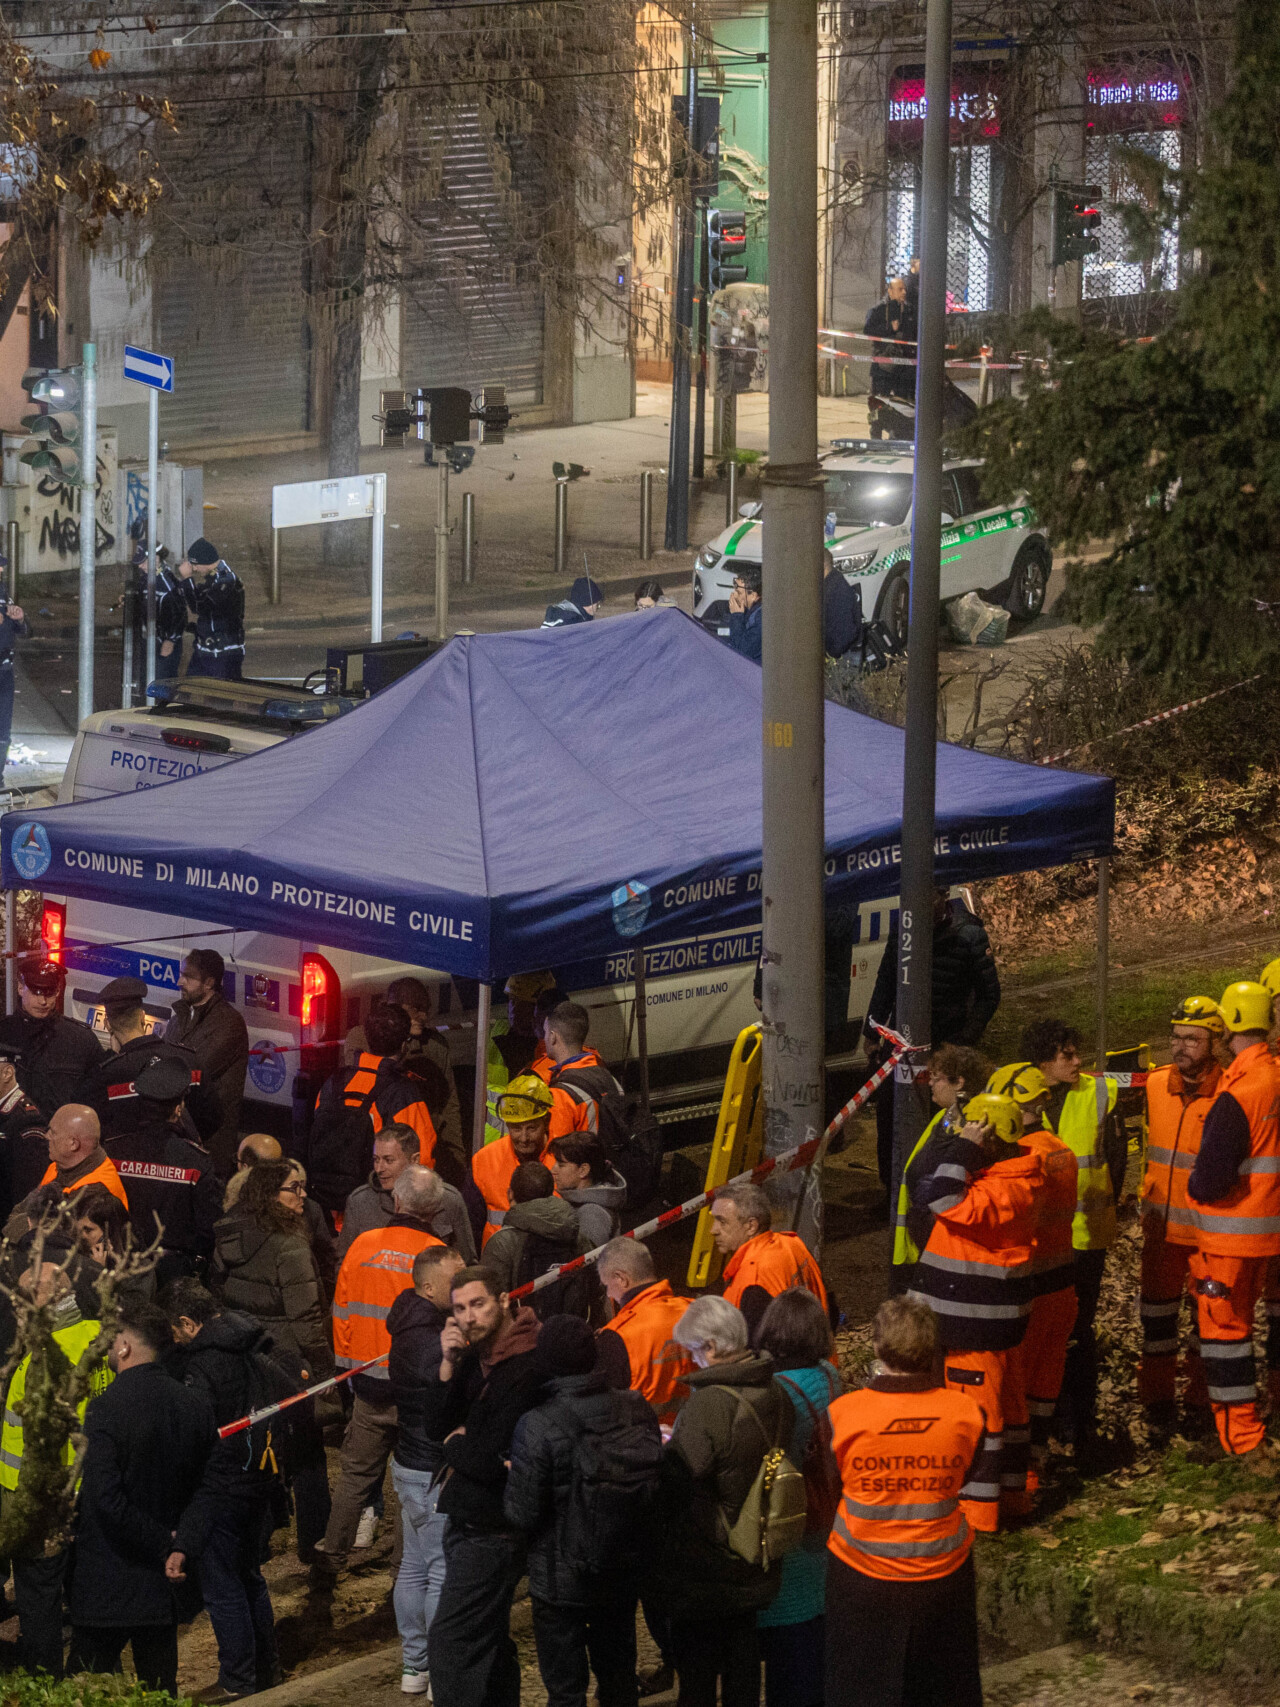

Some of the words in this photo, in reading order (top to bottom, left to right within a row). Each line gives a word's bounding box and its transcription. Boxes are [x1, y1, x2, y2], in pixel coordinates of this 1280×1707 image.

[1149, 81, 1179, 101] vista
[981, 517, 1008, 534] Locale
[663, 872, 737, 909] COMUNE
[959, 825, 1010, 851] CIVILE
[64, 848, 144, 878] COMUNE
[156, 862, 174, 882] DI
[185, 866, 260, 896] MILANO
[270, 881, 396, 925] PROTEZIONE
[409, 910, 474, 942] CIVILE
[605, 942, 708, 982] PROTEZIONE
[713, 935, 761, 962] CIVILE
[139, 958, 176, 983] PCA
[647, 992, 683, 1007] COMUNE
[685, 990, 694, 999] DI
[695, 982, 728, 998] MILANO
[121, 1161, 186, 1180] CARABINIERI
[852, 1454, 964, 1471] CONTROLLO
[862, 1475, 955, 1492] ESERCIZIO
